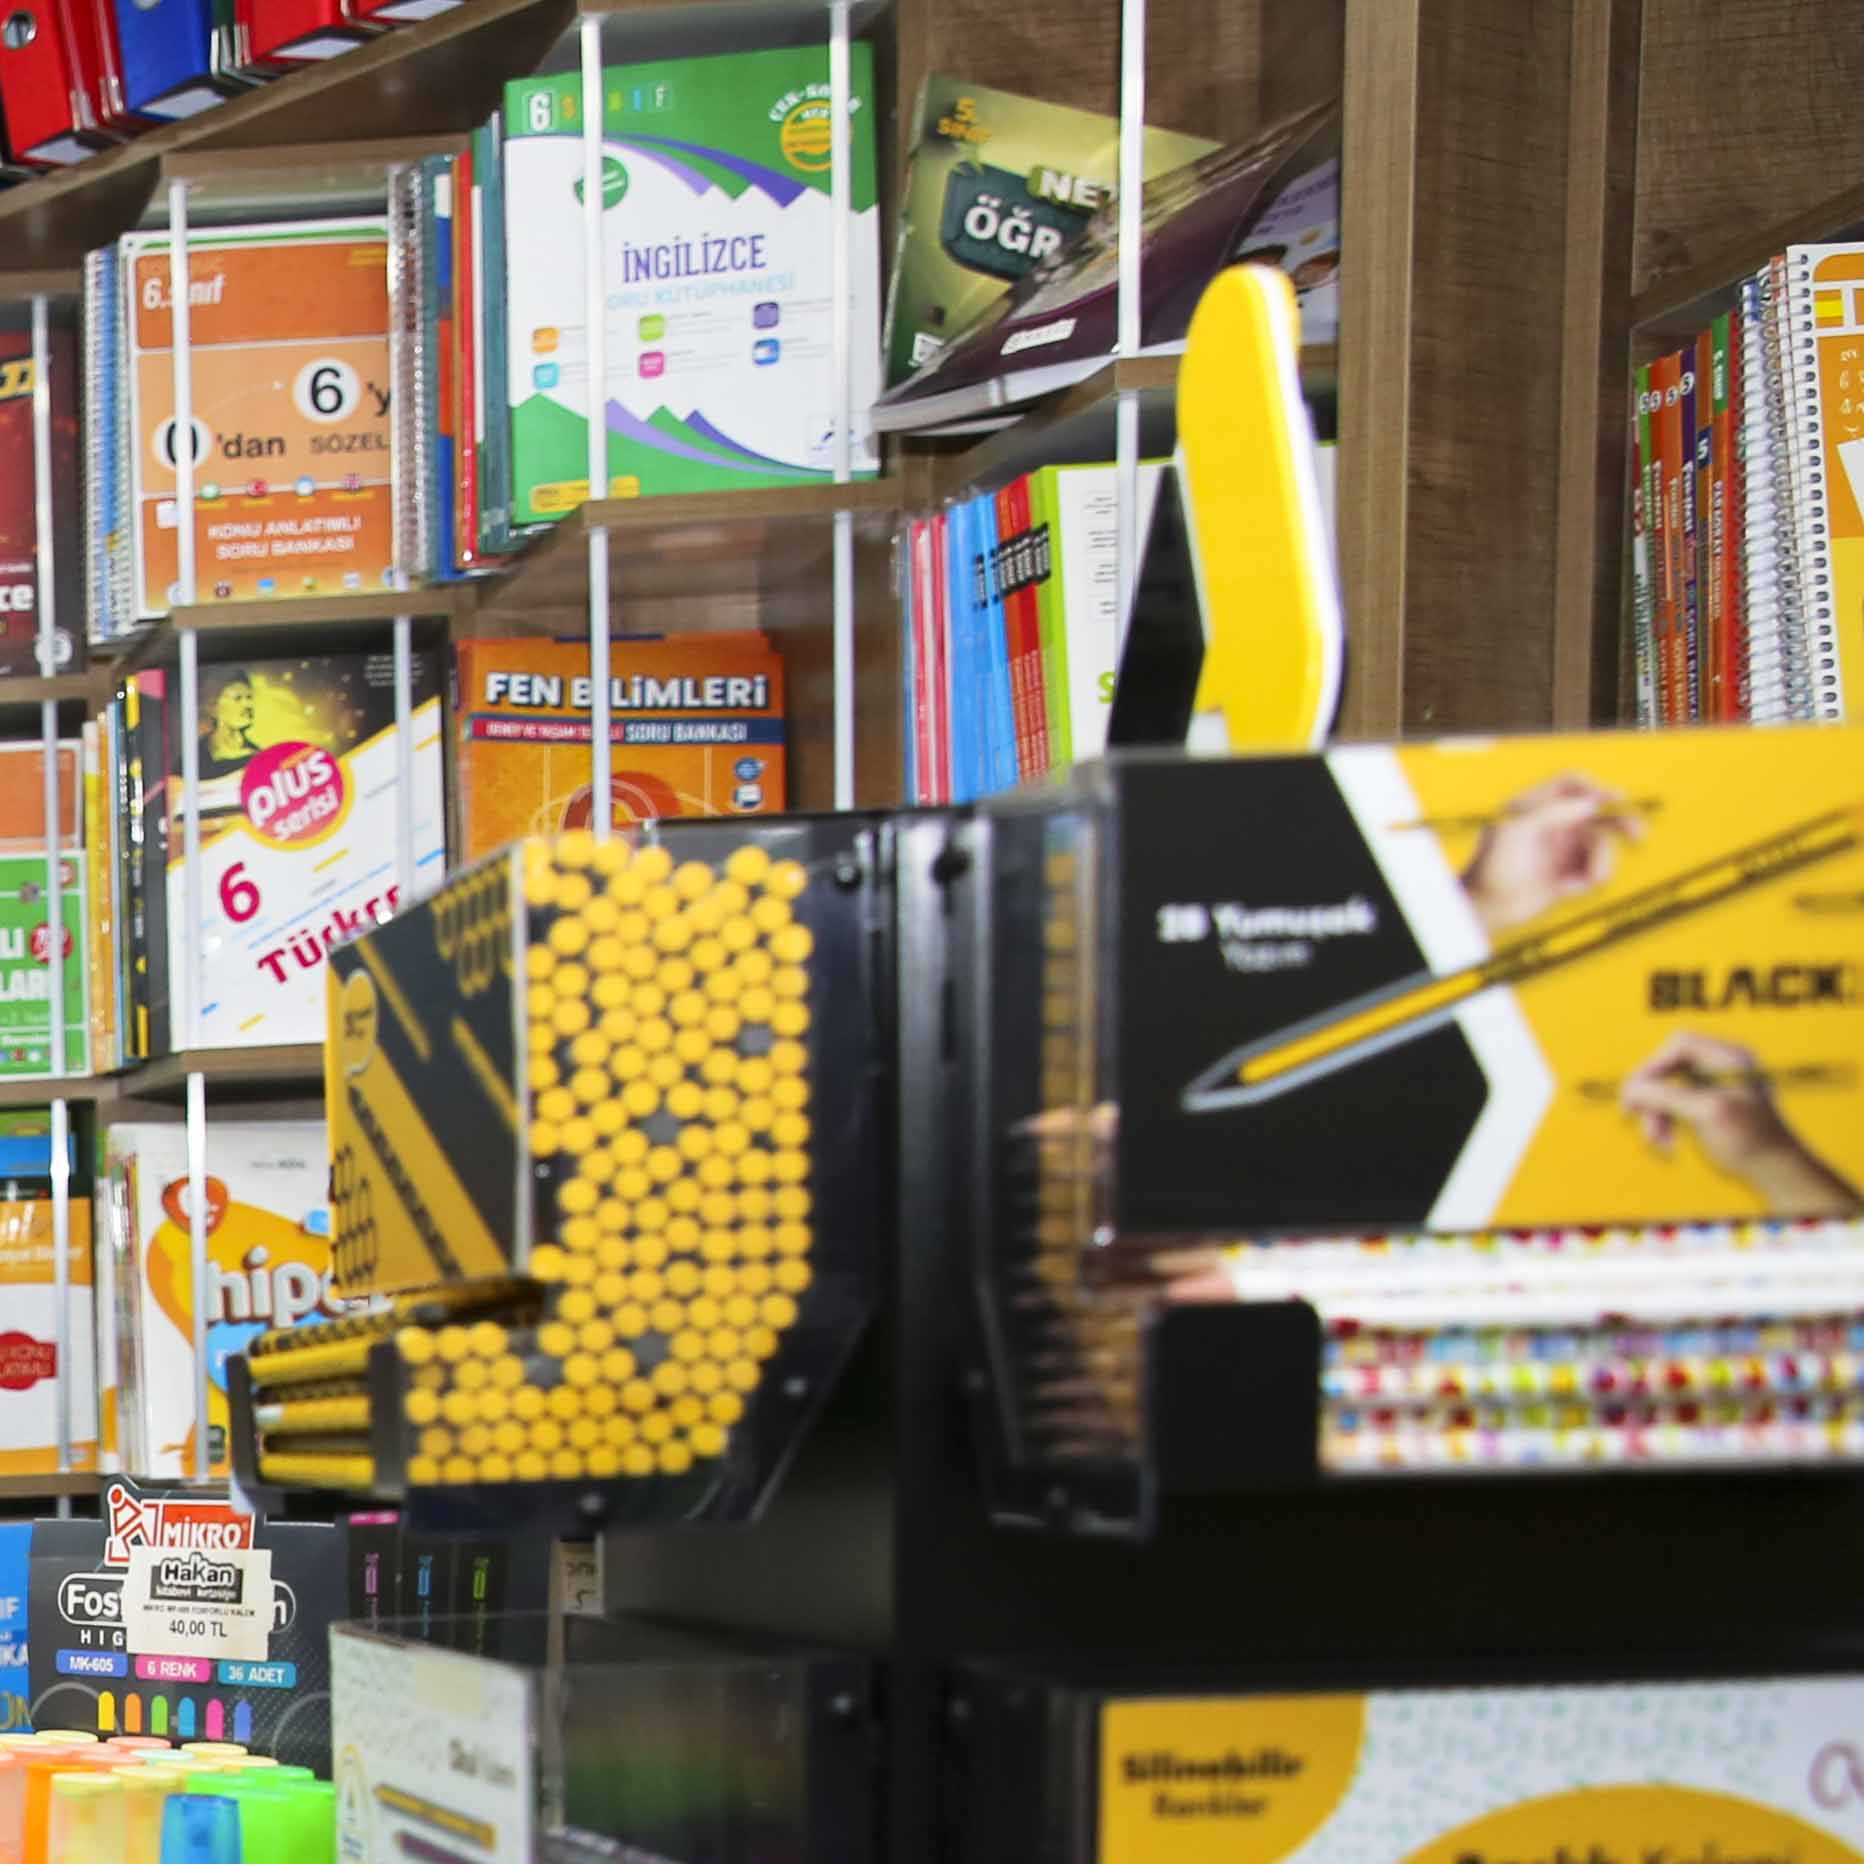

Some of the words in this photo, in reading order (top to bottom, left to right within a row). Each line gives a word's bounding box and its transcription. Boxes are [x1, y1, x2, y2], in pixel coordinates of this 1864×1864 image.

[622, 232, 767, 284] İNGİLİZCE
[308, 366, 344, 415] 6
[485, 671, 561, 706] FEN
[572, 675, 767, 708] BLİMLERİ
[246, 749, 336, 822] plus
[272, 783, 342, 838] serisi
[218, 861, 262, 924] 6
[162, 1516, 242, 1549] MİKRO
[209, 1621, 228, 1638] TL
[159, 1661, 198, 1678] RENK
[228, 1666, 244, 1681] 36
[247, 1667, 286, 1684] ADET
